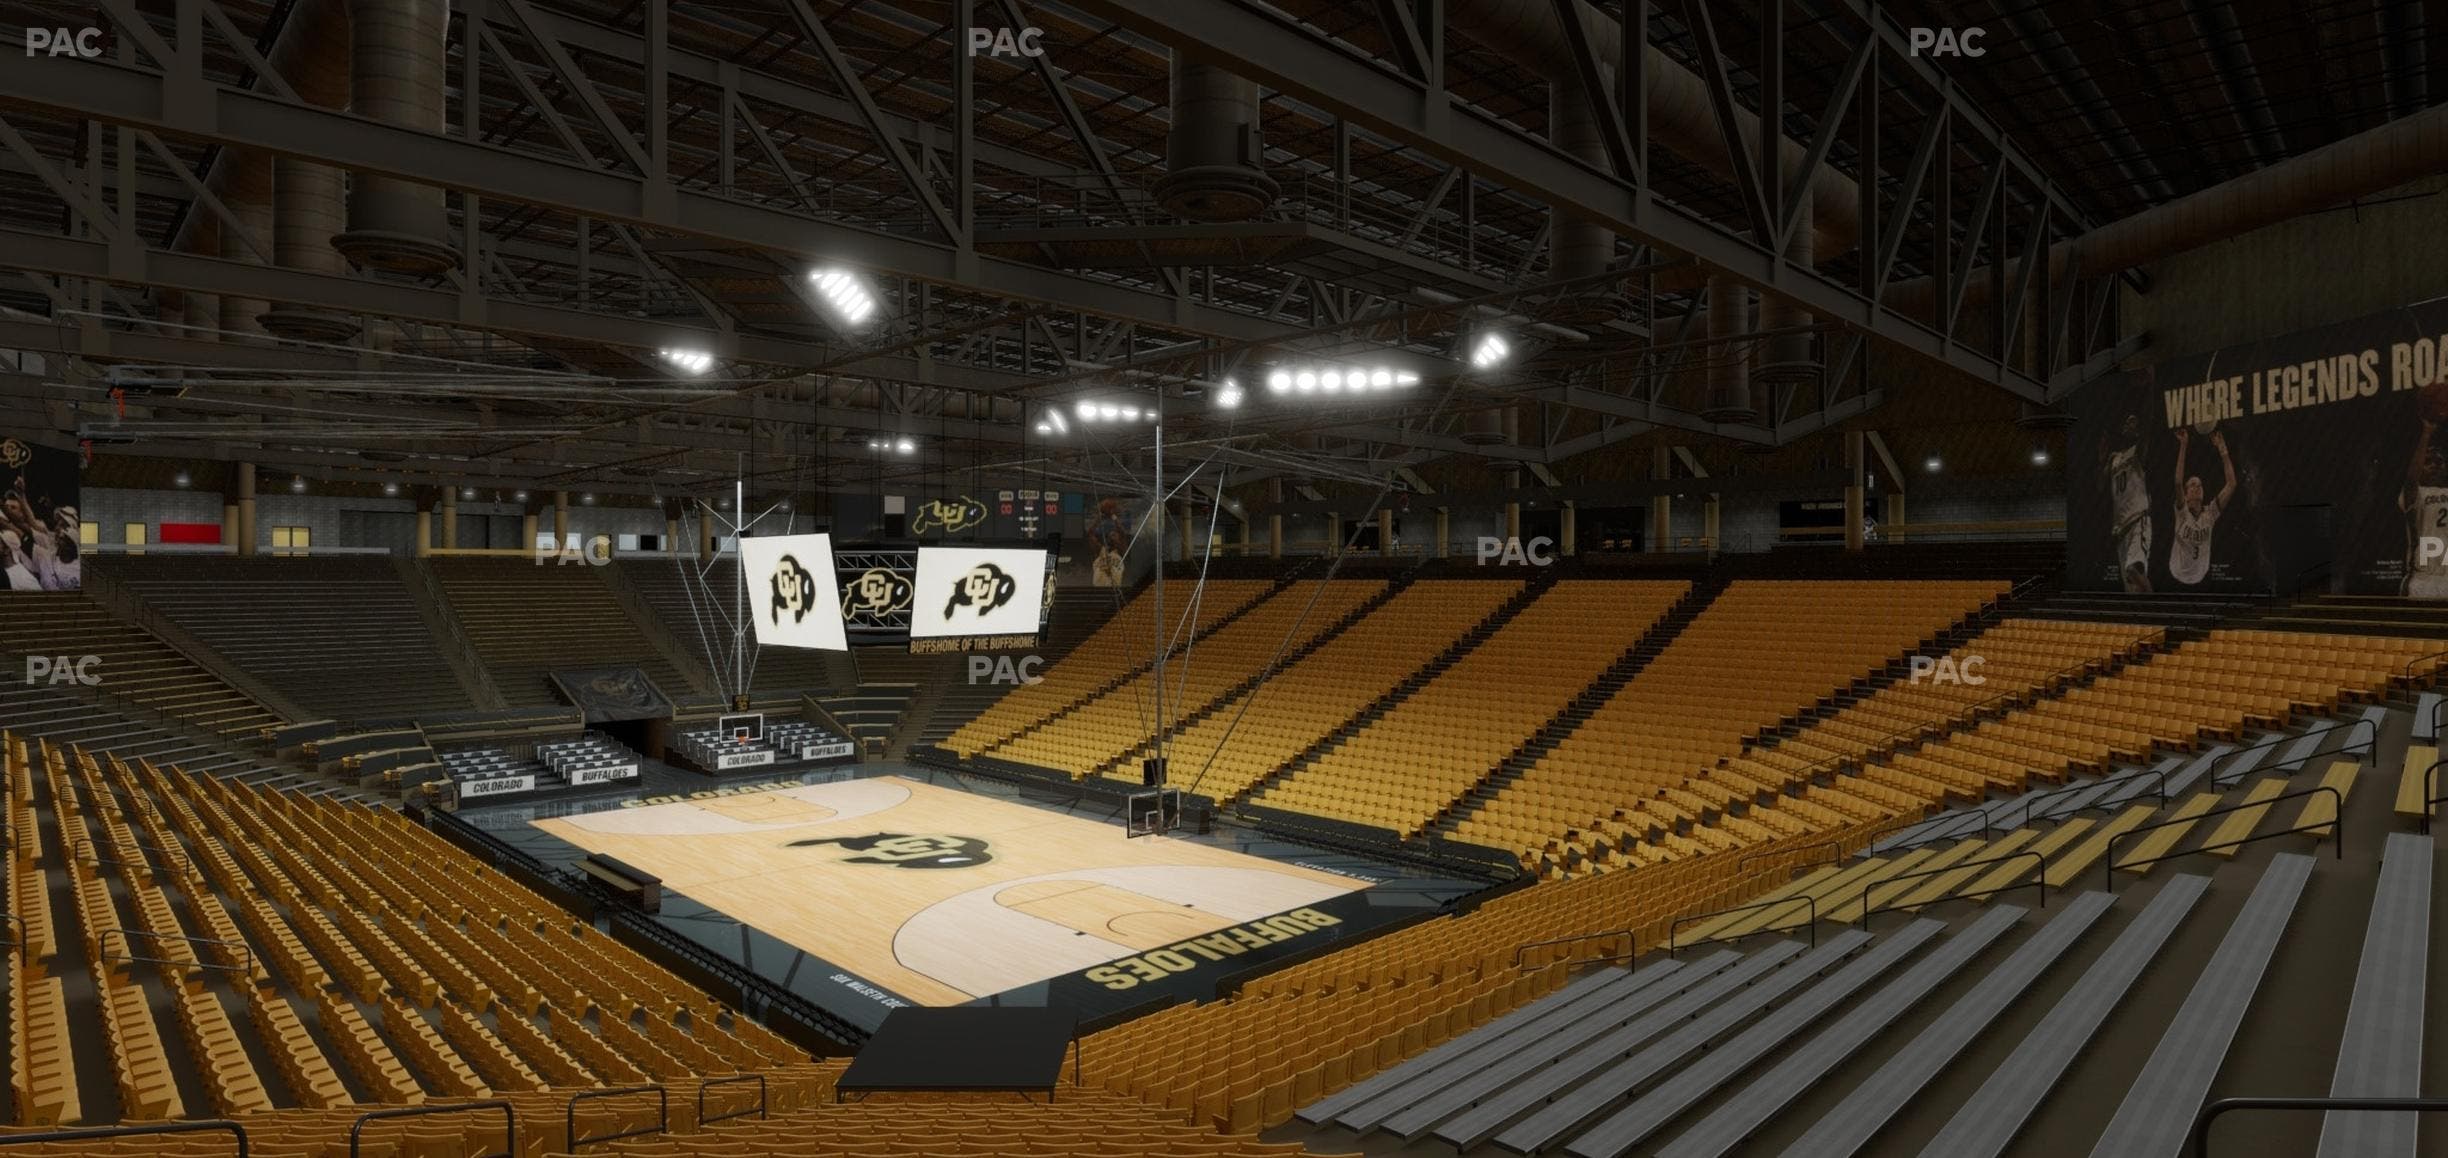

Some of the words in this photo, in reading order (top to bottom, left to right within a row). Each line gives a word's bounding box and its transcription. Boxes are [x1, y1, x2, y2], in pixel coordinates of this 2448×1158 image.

[2164, 375, 2245, 429] WHERE
[2252, 349, 2381, 415] LEGENDS
[961, 638, 972, 652] OF
[974, 637, 988, 651] THE
[810, 745, 847, 757] BUFFALOES
[726, 753, 766, 766] COLORADO
[582, 767, 628, 781] BUFFALOES
[473, 779, 523, 793] COLORADO
[1085, 907, 1343, 990] BUFFALOES
